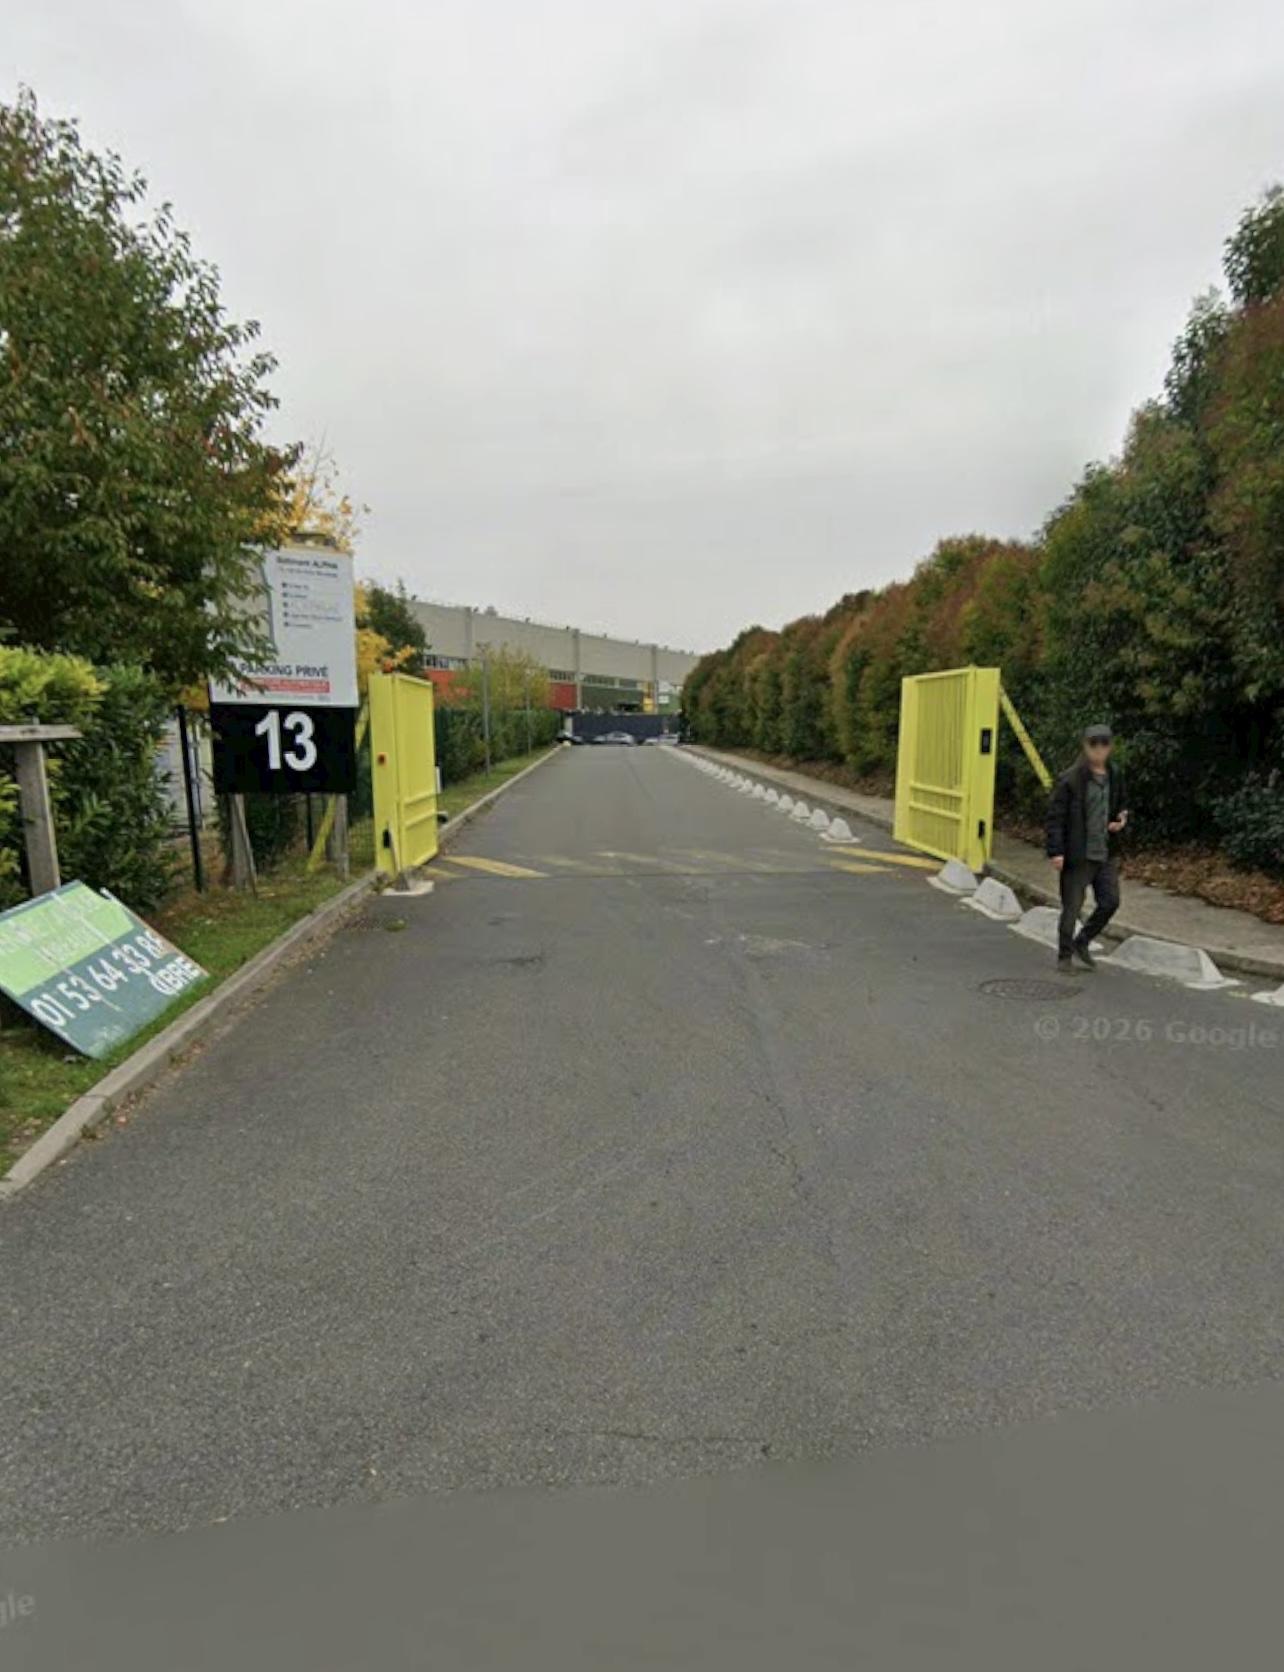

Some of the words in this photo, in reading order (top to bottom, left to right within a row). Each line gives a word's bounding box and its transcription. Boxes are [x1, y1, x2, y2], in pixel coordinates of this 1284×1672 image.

[254, 709, 318, 771] 13
[30, 992, 76, 1027] 01
[56, 975, 103, 1010] 53
[87, 958, 128, 991] 64
[111, 943, 151, 975] 33
